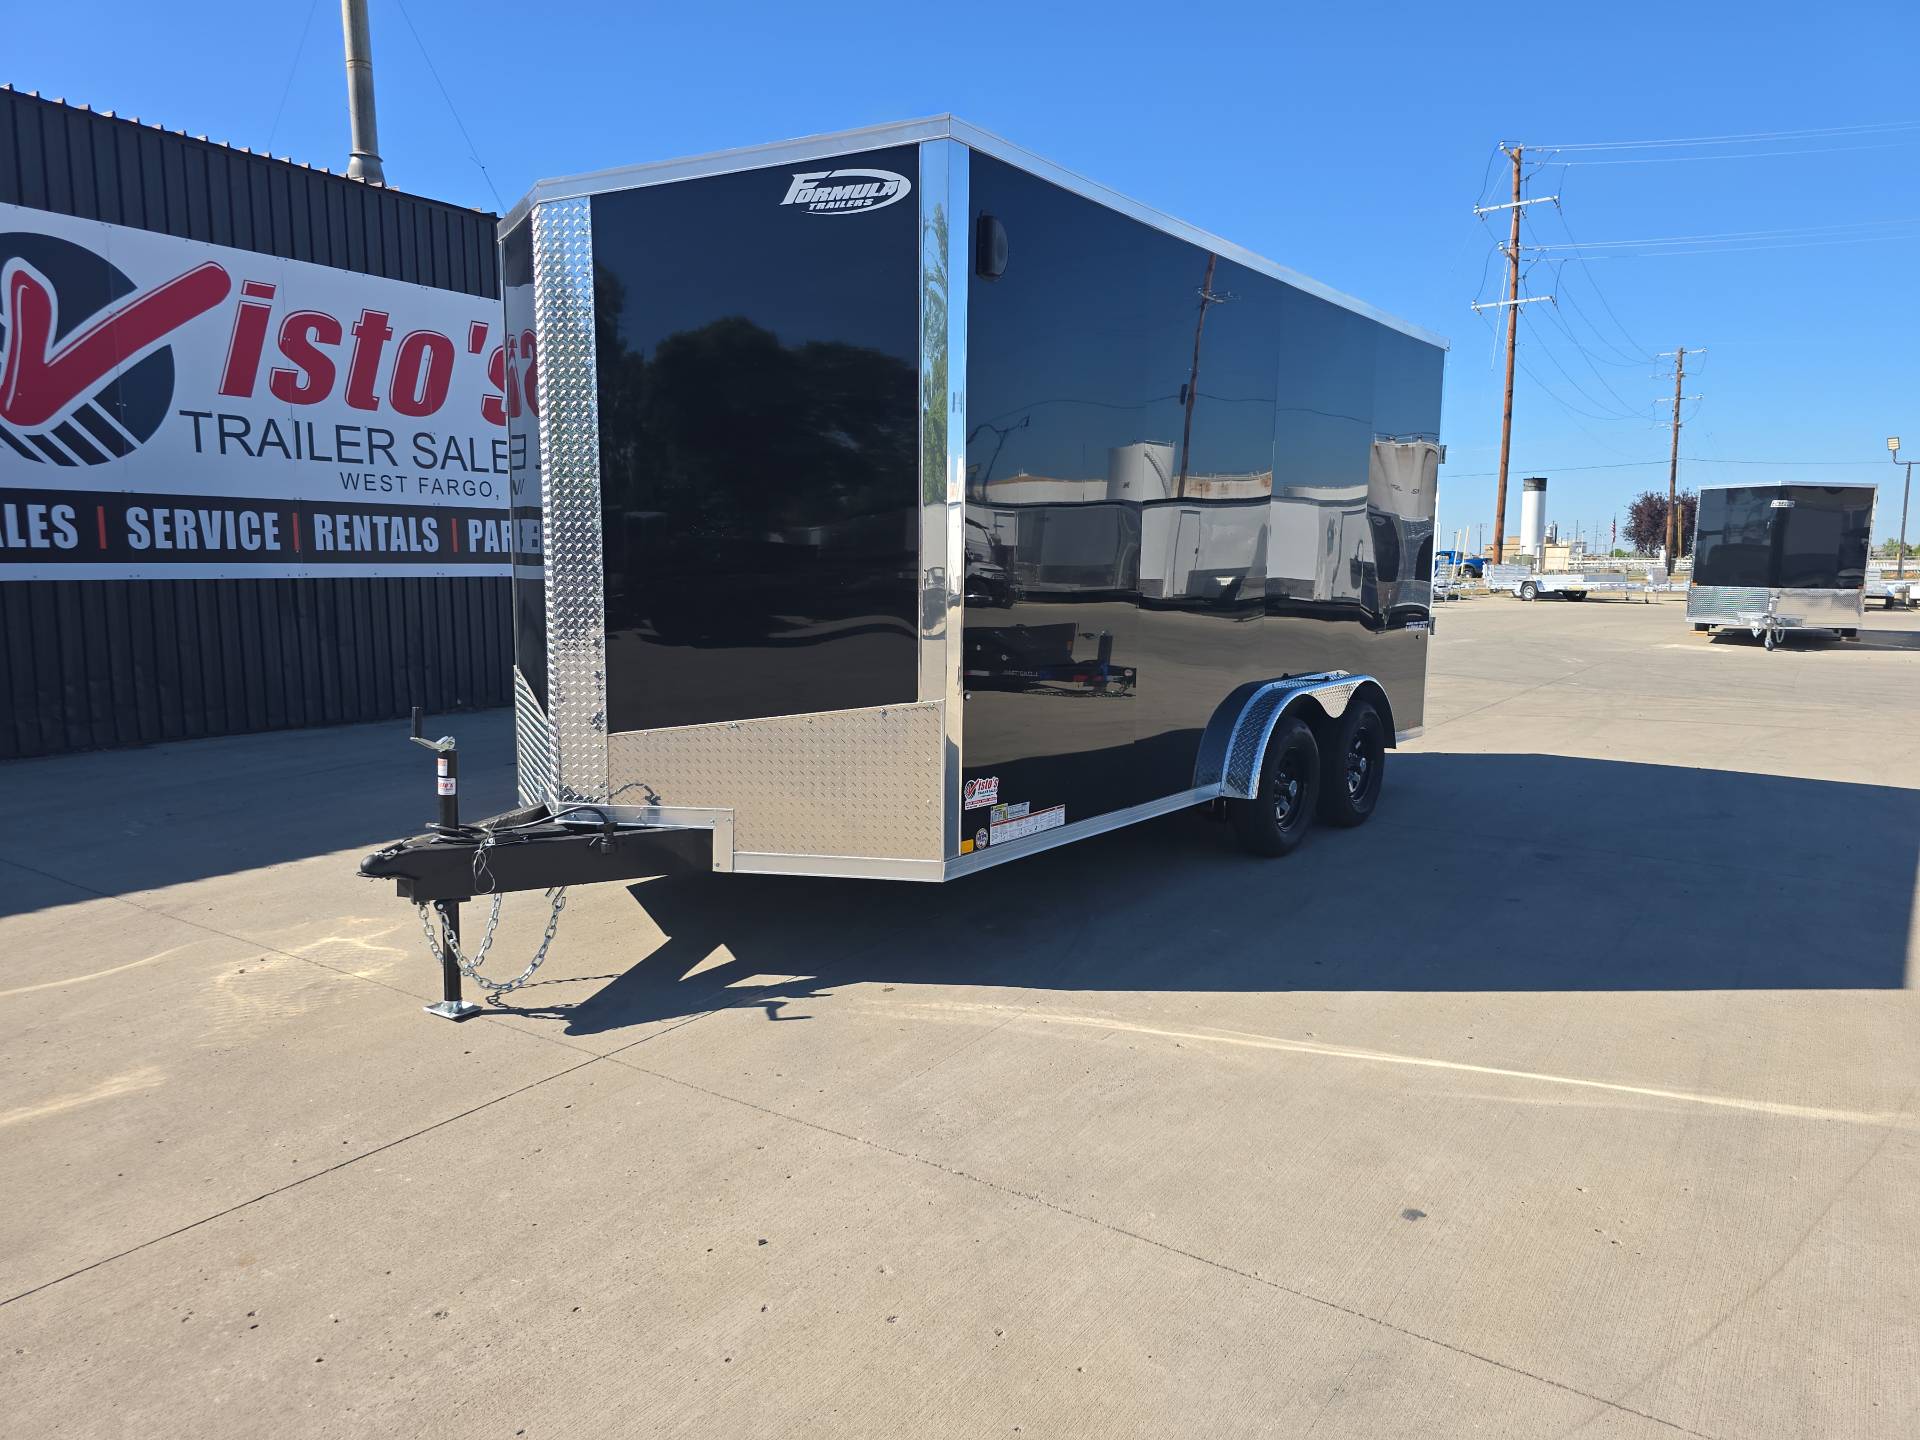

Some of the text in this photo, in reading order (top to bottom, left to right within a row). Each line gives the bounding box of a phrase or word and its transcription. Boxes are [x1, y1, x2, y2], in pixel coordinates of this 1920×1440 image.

[779, 170, 900, 205] FORMULA
[808, 198, 874, 211] TRAILERS
[179, 409, 399, 467] TRAILER
[339, 471, 500, 500] WEST FARGO,
[0, 503, 79, 550] LES
[125, 507, 281, 552] SERVICE
[313, 513, 440, 553] RENTALS
